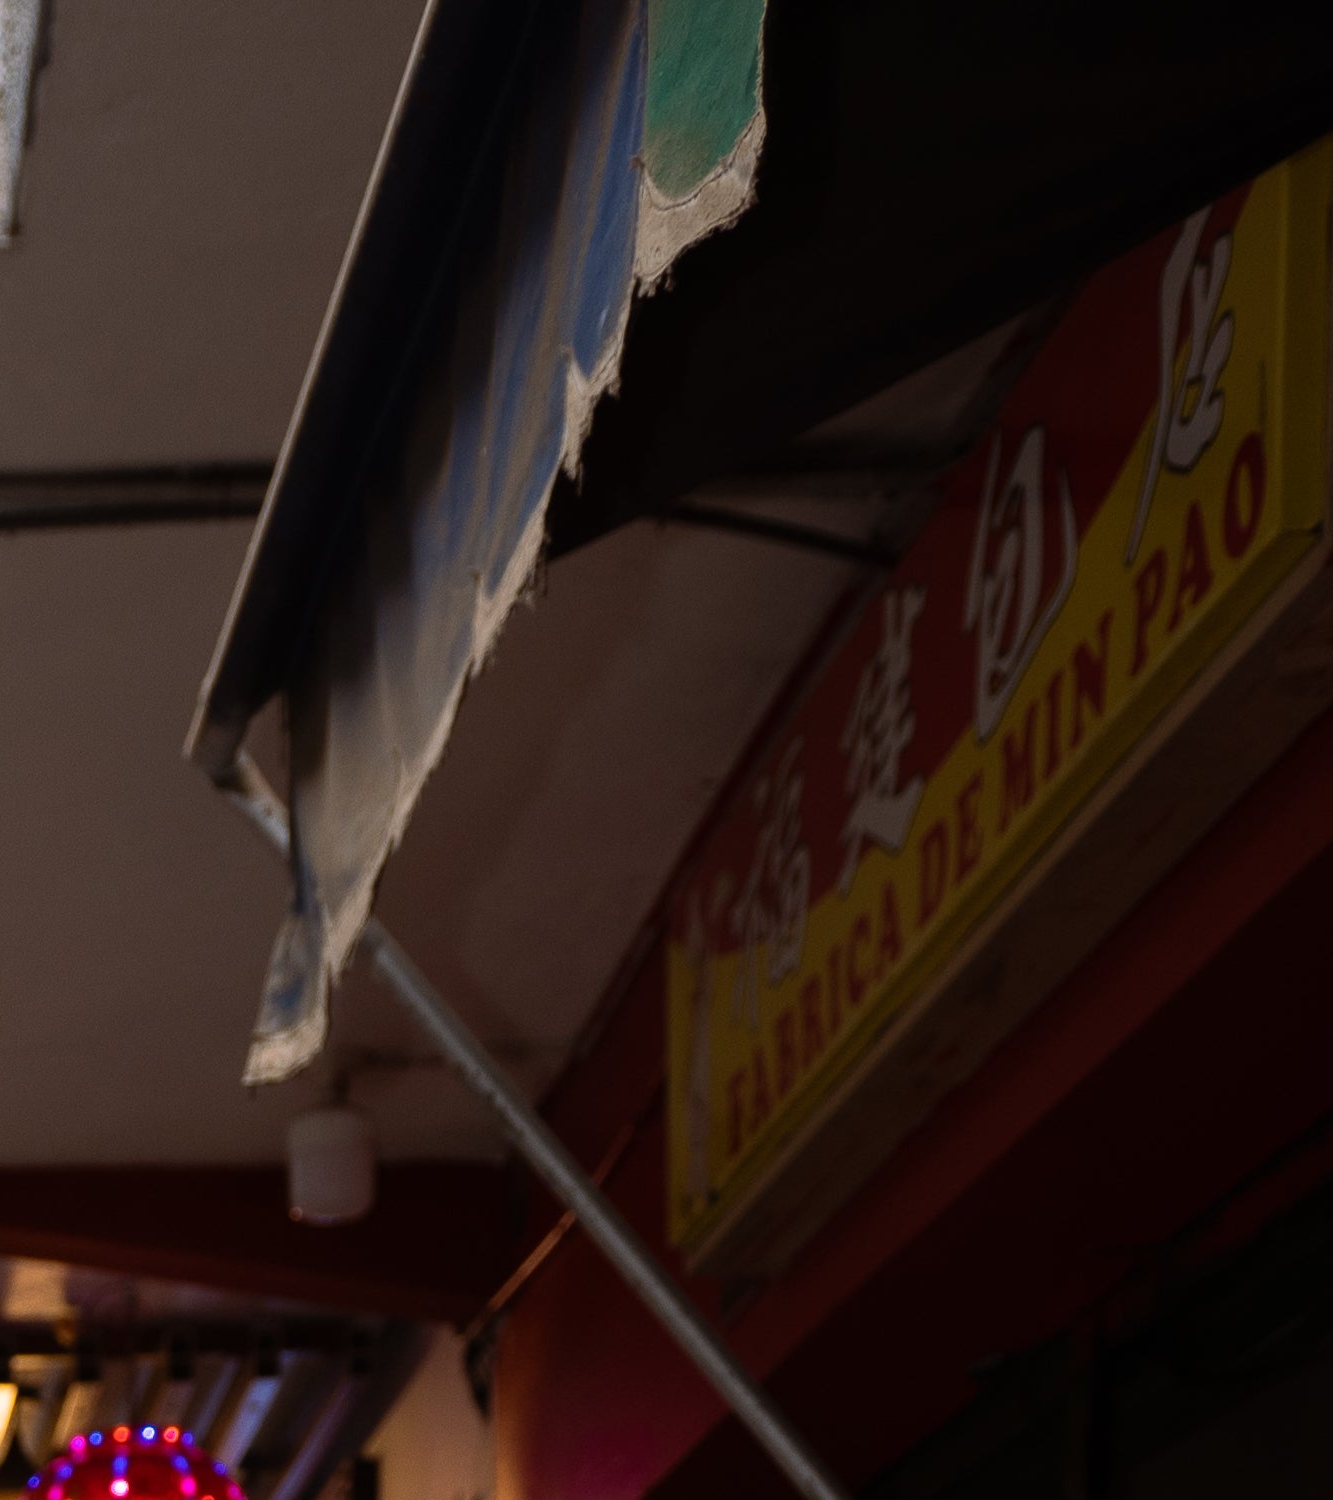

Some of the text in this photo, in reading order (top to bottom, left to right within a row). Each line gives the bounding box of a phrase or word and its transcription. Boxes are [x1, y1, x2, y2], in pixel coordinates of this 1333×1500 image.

[726, 428, 1266, 1159] FABRICA DE MIN PAO
